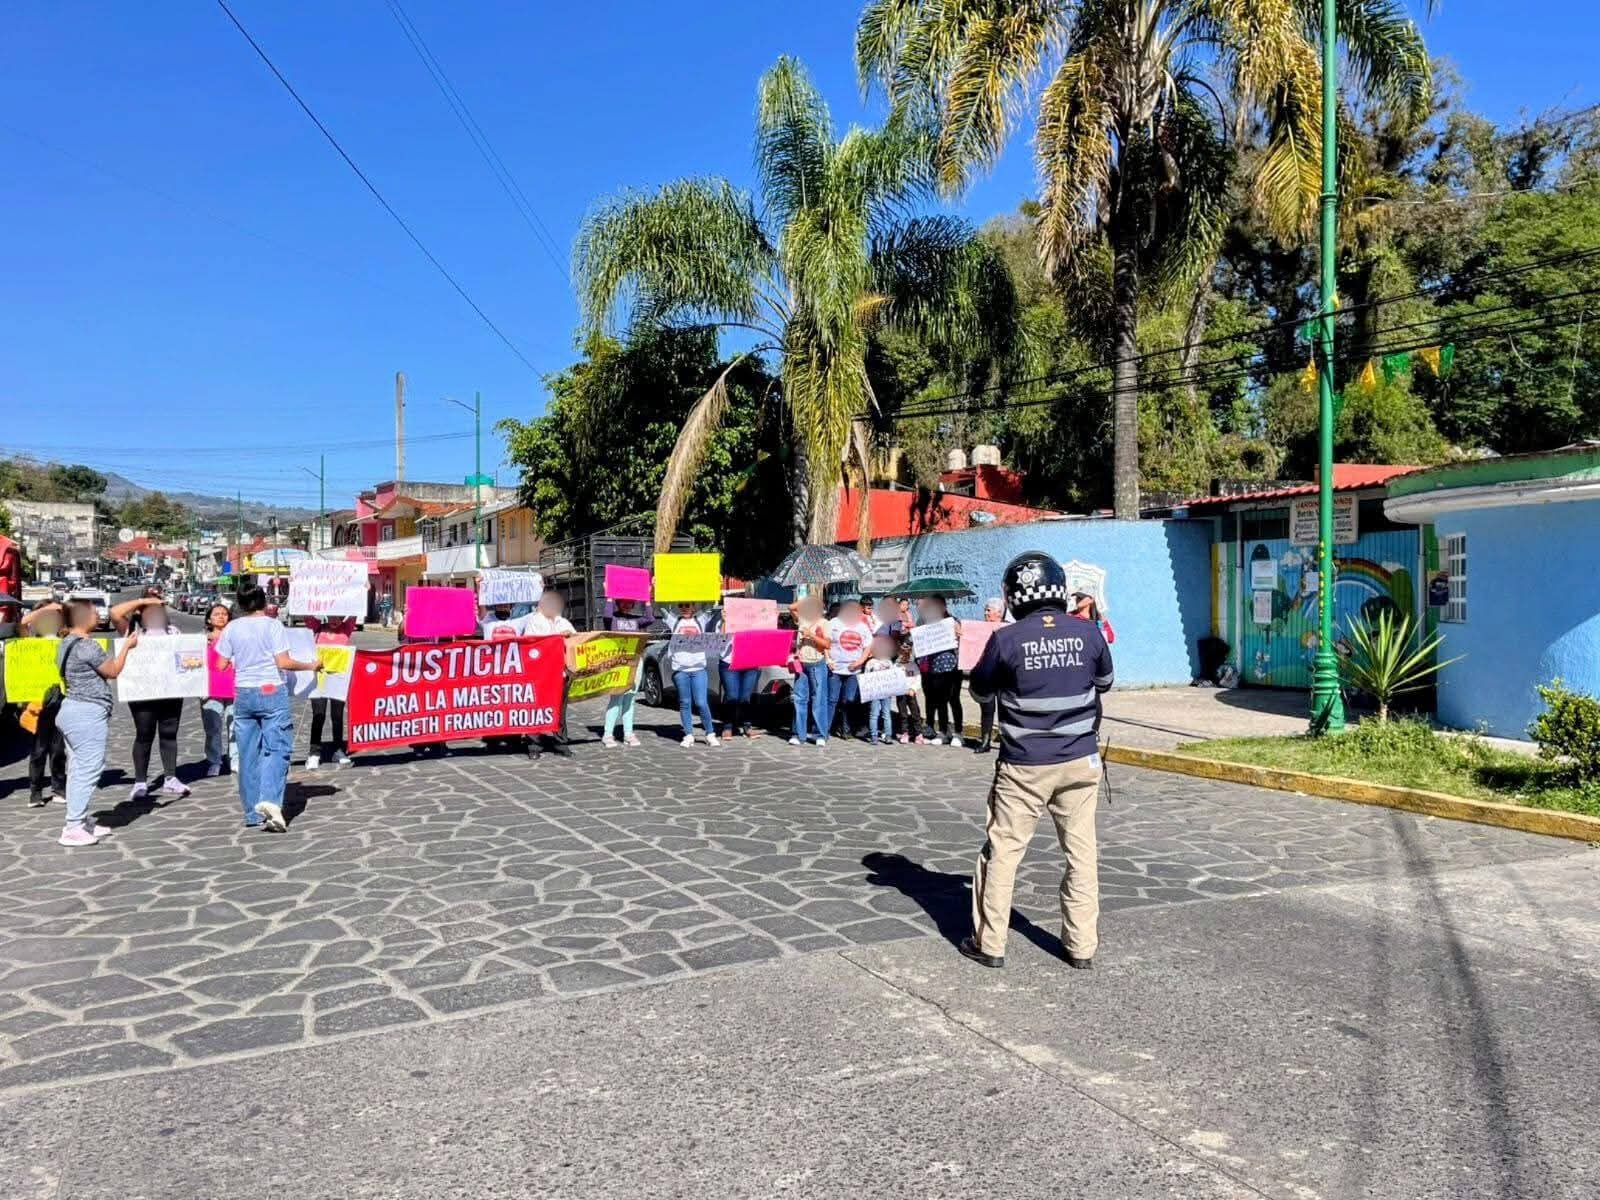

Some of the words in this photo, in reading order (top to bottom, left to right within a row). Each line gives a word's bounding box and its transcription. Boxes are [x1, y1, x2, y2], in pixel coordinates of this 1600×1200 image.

[1021, 637, 1084, 656] TRÁNSITO
[1024, 653, 1083, 671] ESTATAL
[385, 642, 524, 687] JUSTICIA
[374, 692, 419, 718] PARA
[425, 690, 446, 711] LA
[452, 683, 535, 708] MAESTRA
[352, 714, 439, 743] KINNERETH
[444, 710, 503, 731] FRANCO
[508, 707, 554, 727] ROJAS
